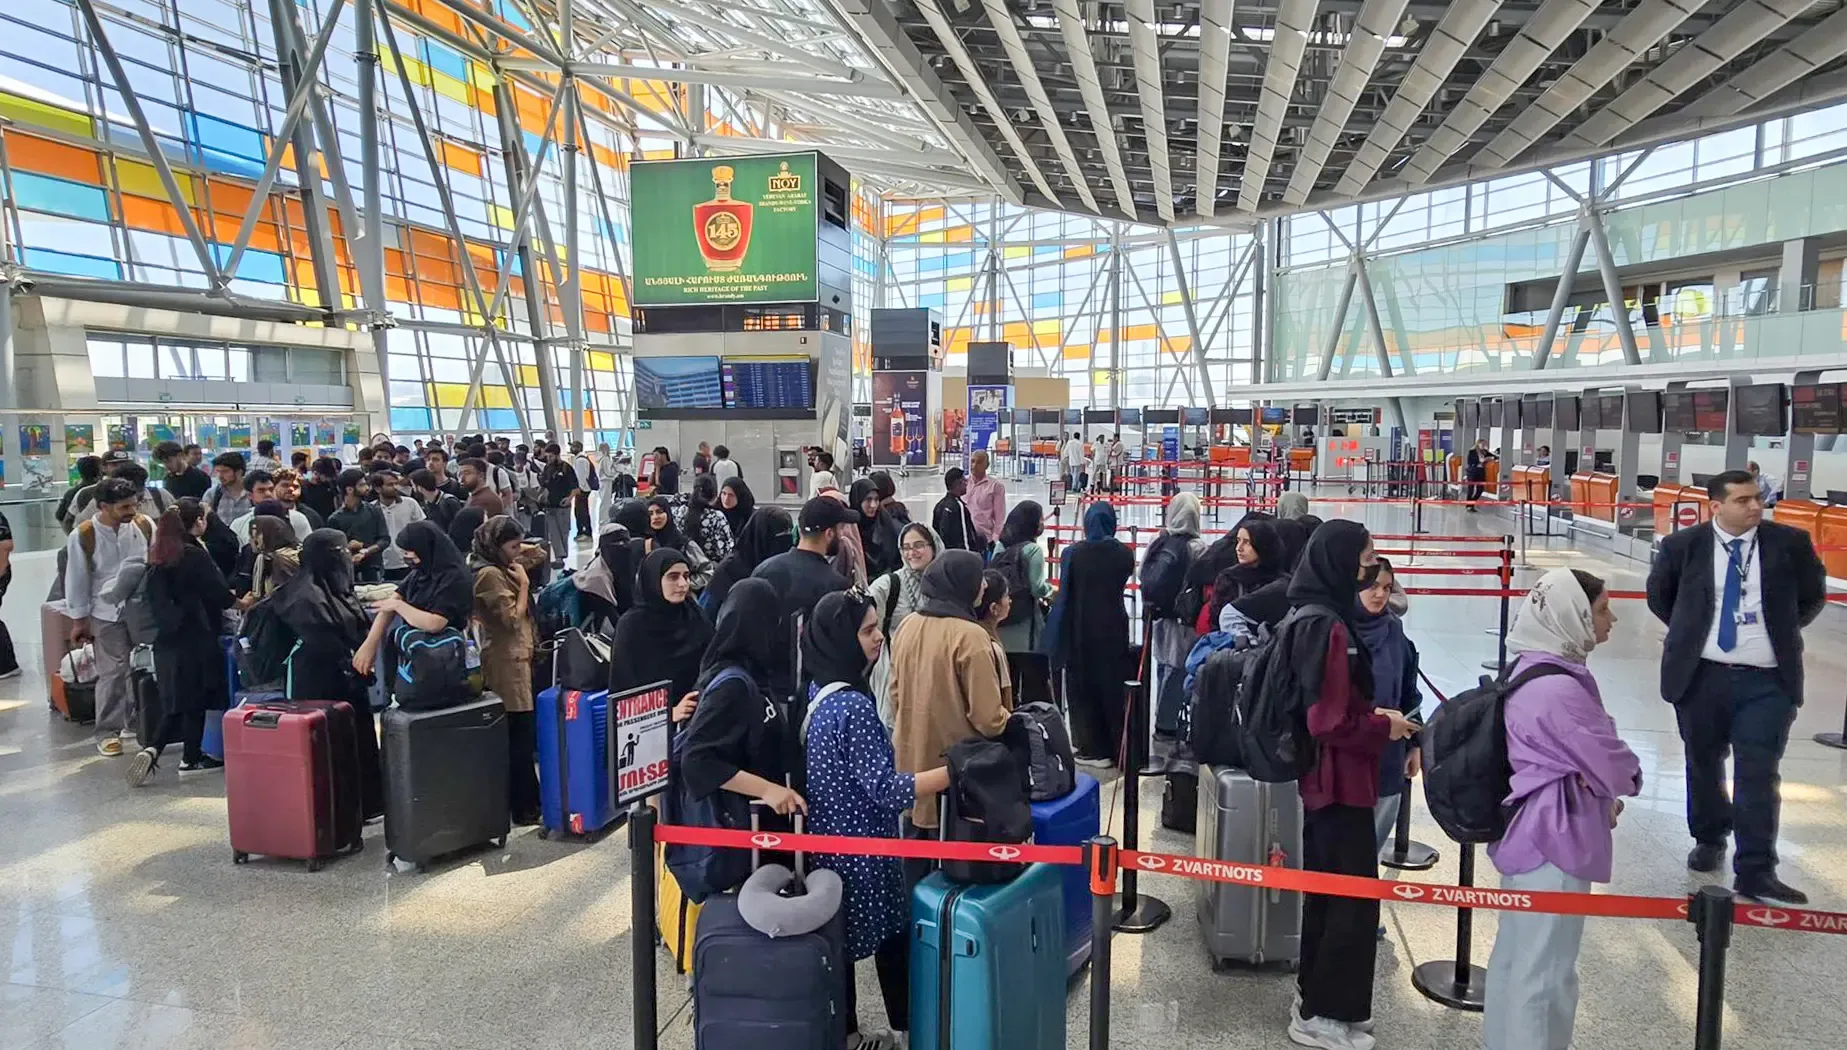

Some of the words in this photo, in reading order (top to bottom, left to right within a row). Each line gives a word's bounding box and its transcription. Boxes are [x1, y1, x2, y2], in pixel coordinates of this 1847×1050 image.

[772, 178, 797, 189] NOY
[708, 223, 739, 239] 145
[1172, 859, 1263, 882] ZVARTNOTS
[1432, 887, 1532, 908] ZVARTNOTS
